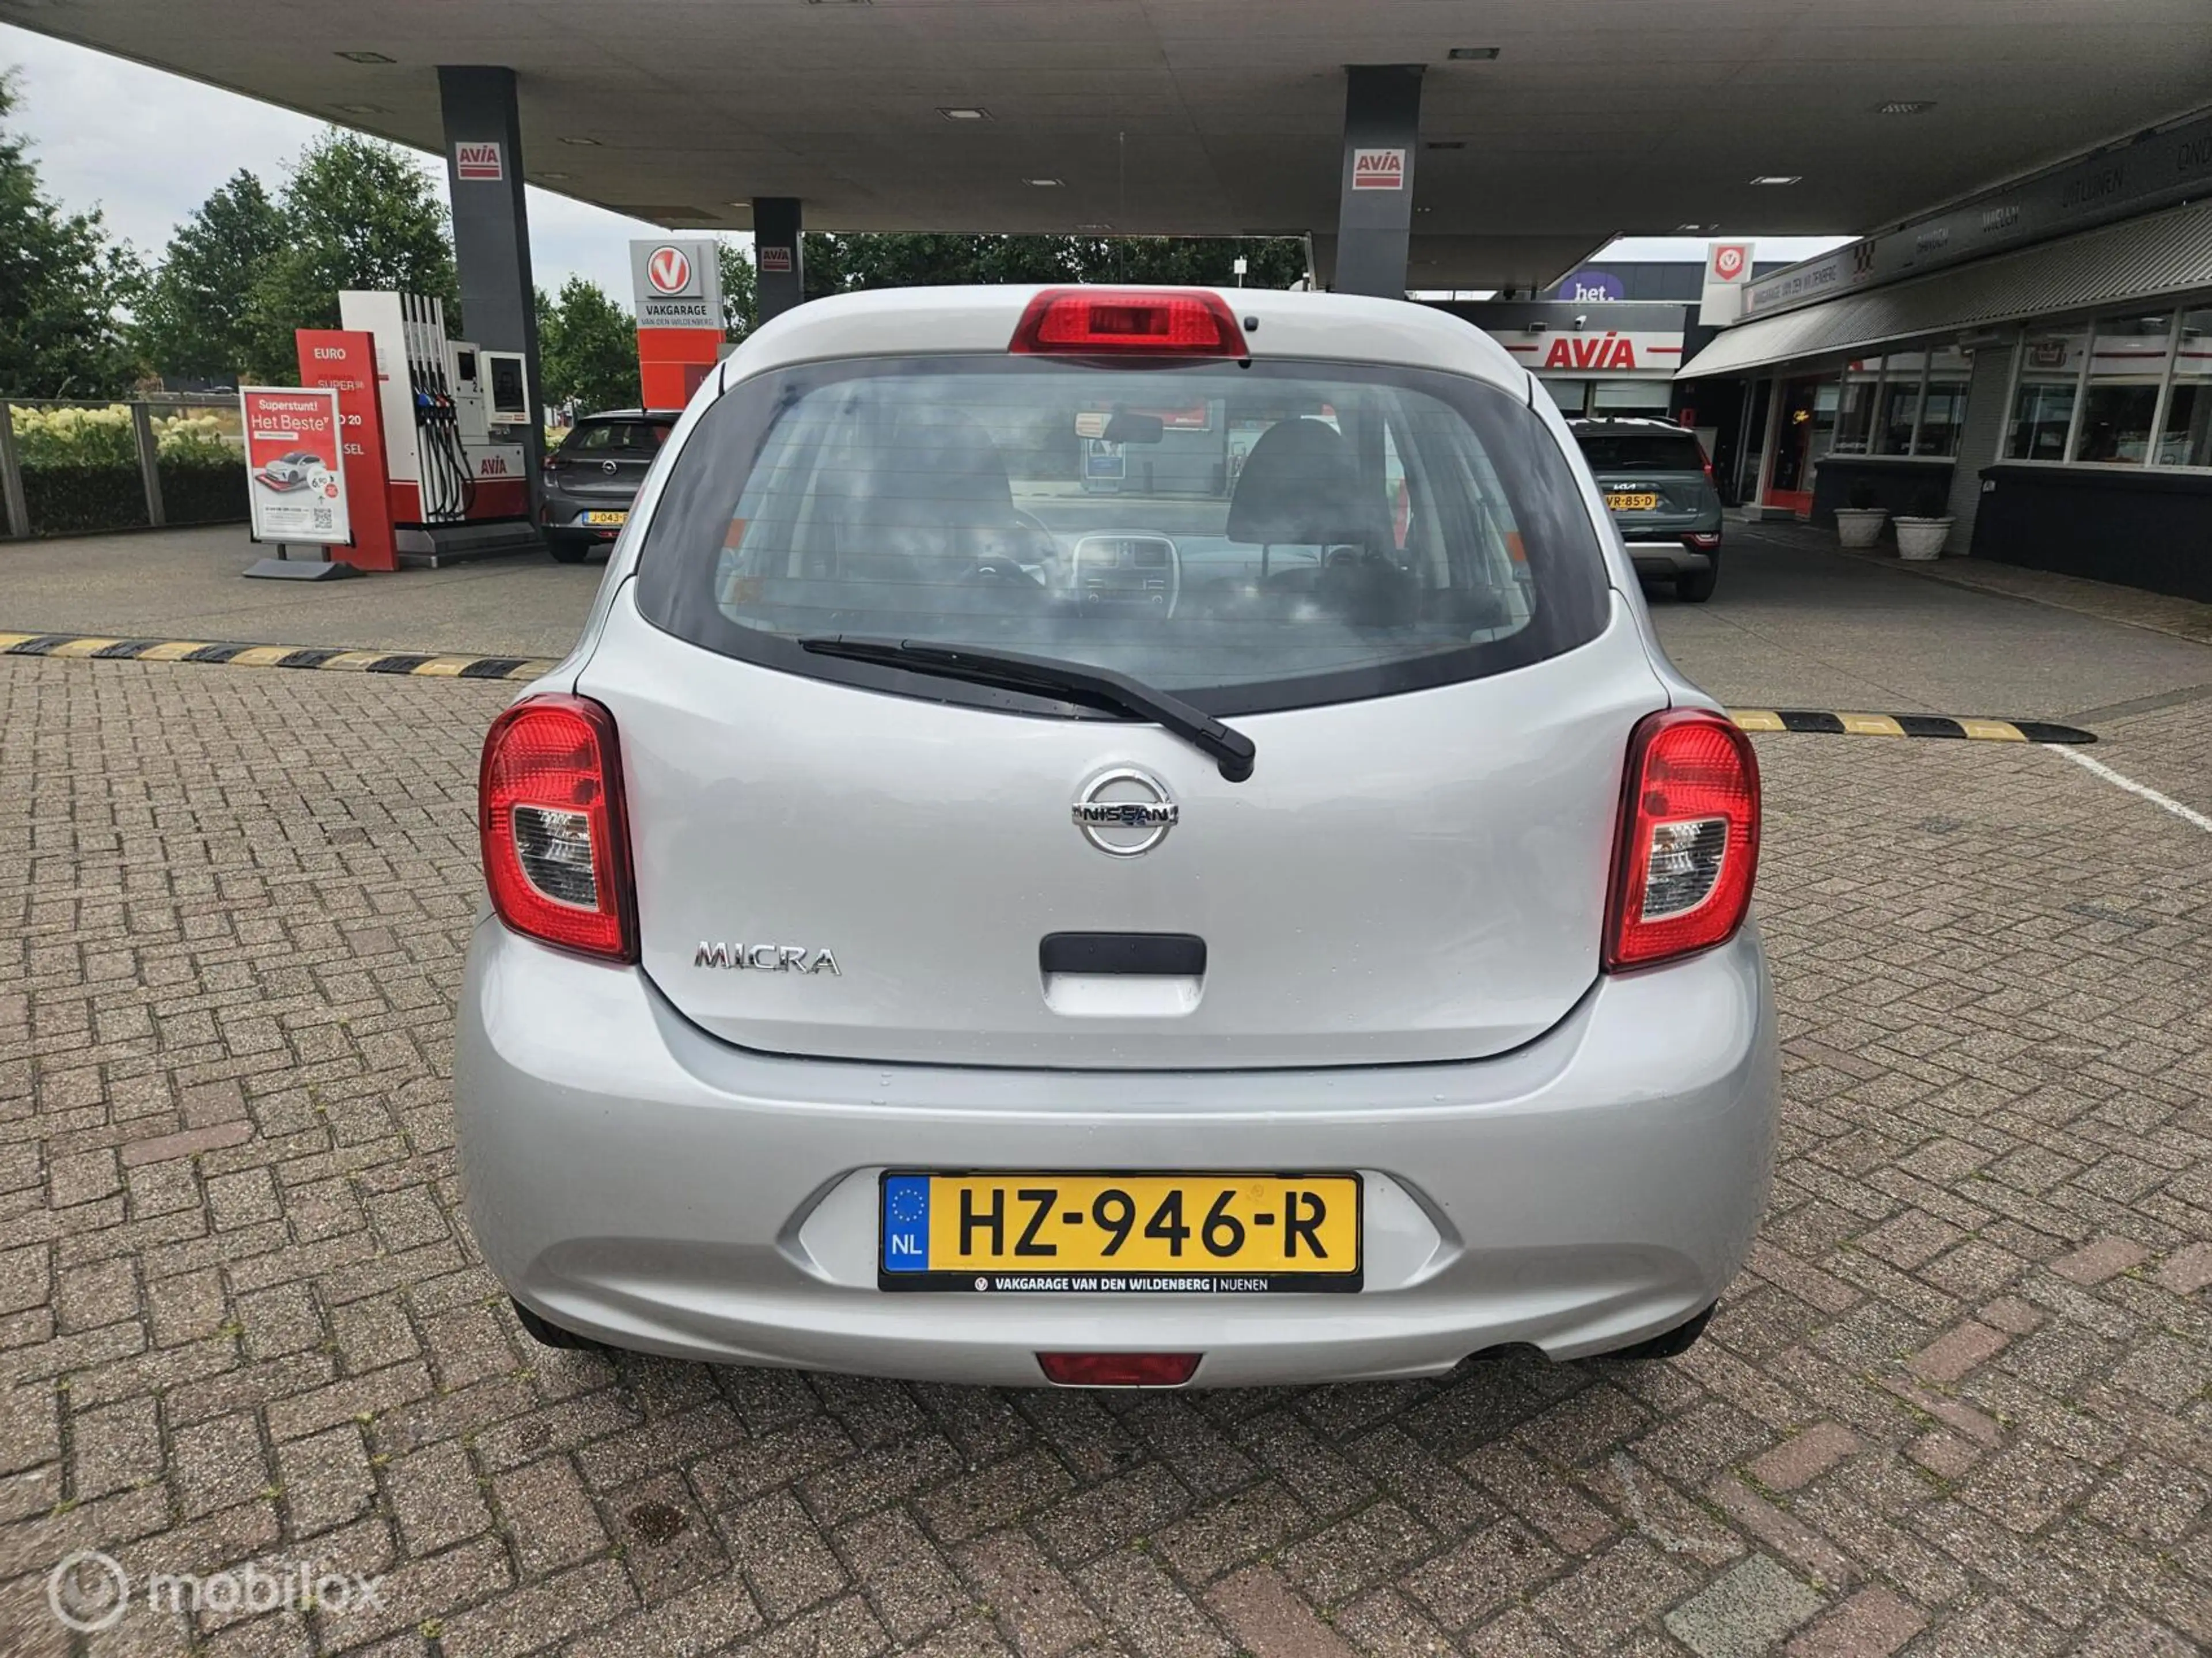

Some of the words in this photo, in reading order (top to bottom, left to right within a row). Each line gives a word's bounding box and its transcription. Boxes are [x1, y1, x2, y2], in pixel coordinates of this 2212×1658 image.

[460, 145, 499, 164] AVIA
[1357, 150, 1401, 171] AVIA
[763, 248, 789, 261] AVIA
[646, 305, 707, 316] VAKGARAGE
[314, 348, 346, 360] EURO
[1545, 331, 1636, 370] AVIA
[318, 380, 355, 391] SUPER
[259, 399, 318, 412] Superstunt!
[251, 413, 278, 428] Het
[349, 414, 362, 426] 20
[481, 454, 507, 475] AVIA
[1083, 807, 1169, 822] NISSAN
[694, 940, 842, 976] MICRA
[959, 1188, 1328, 1259] HZ-946-R
[891, 1234, 923, 1255] NL
[995, 1277, 1069, 1291] VAKGARAGE
[1072, 1277, 1098, 1291] VAN
[1101, 1277, 1127, 1291] DEN
[1130, 1277, 1211, 1291] WILDENBERG
[1220, 1278, 1268, 1291] NUENEN
